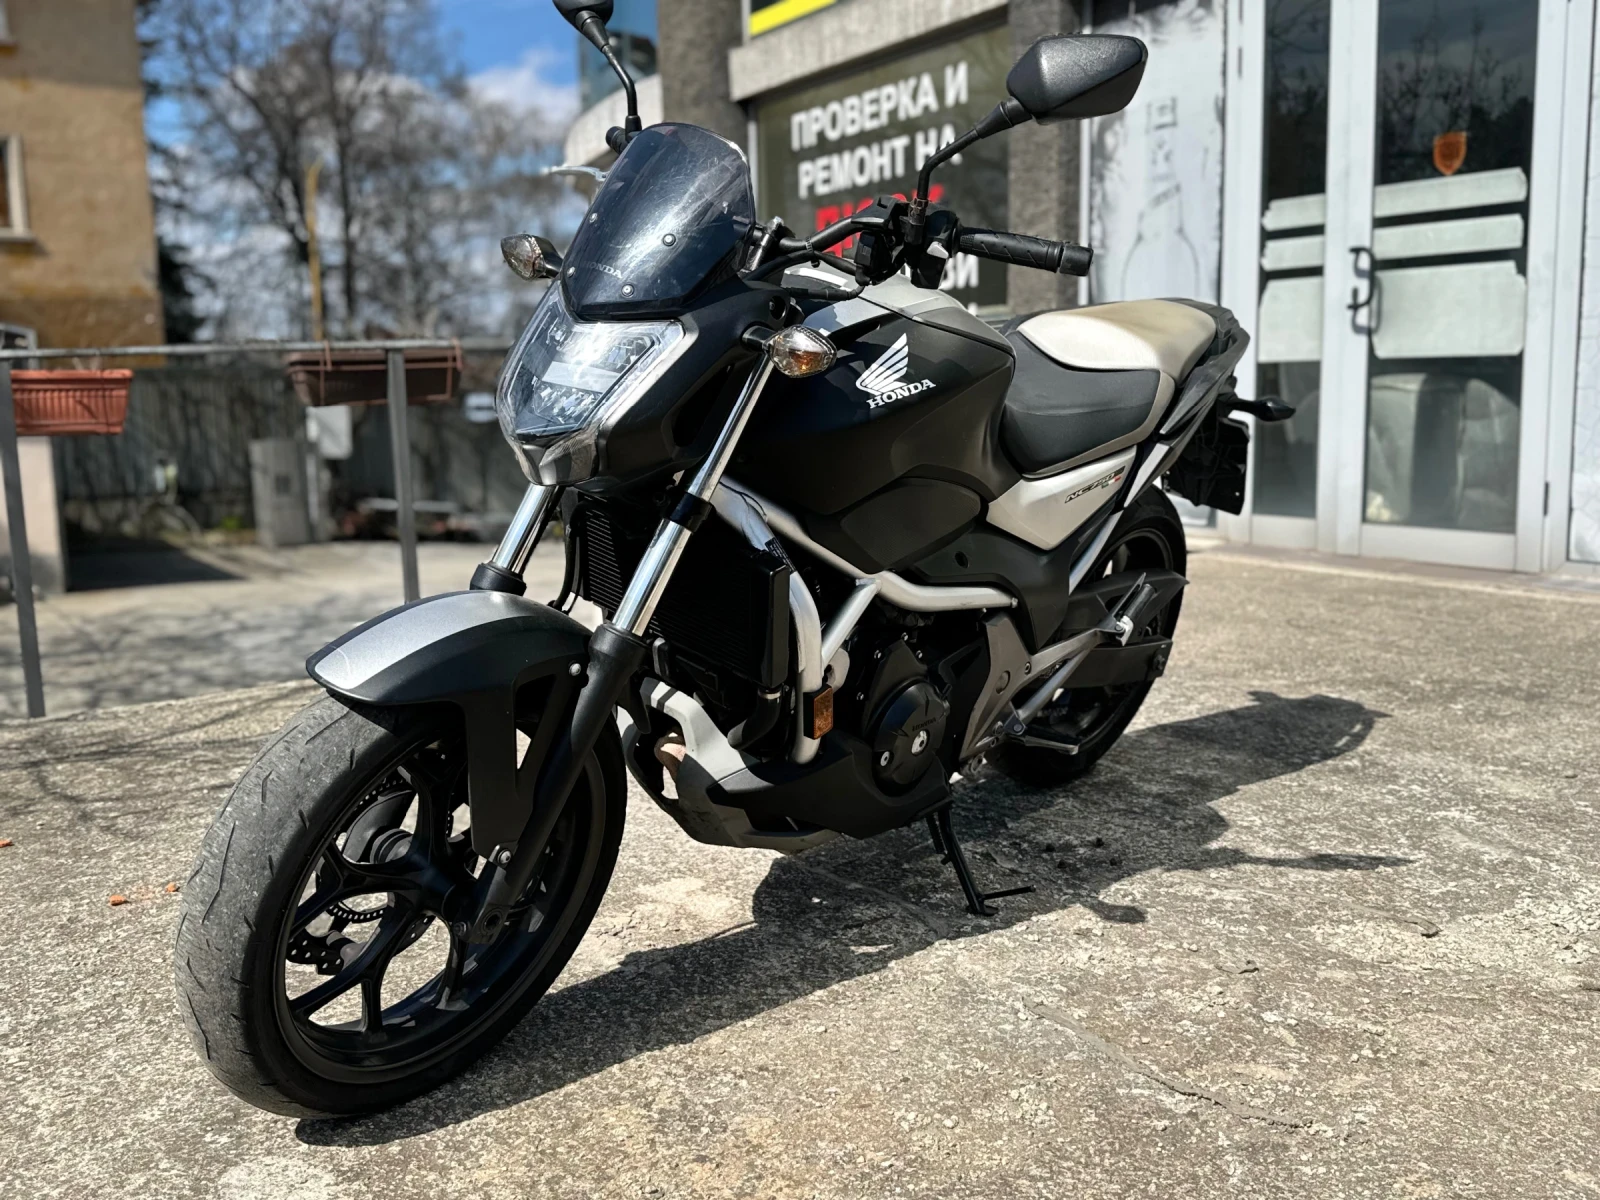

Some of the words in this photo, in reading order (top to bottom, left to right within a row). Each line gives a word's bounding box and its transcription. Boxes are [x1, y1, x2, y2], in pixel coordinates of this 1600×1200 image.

[791, 72, 938, 151] ПРОВЕРКА
[944, 60, 968, 108] И
[798, 134, 911, 199] РЕМОНТ
[866, 379, 936, 409] HONDA
